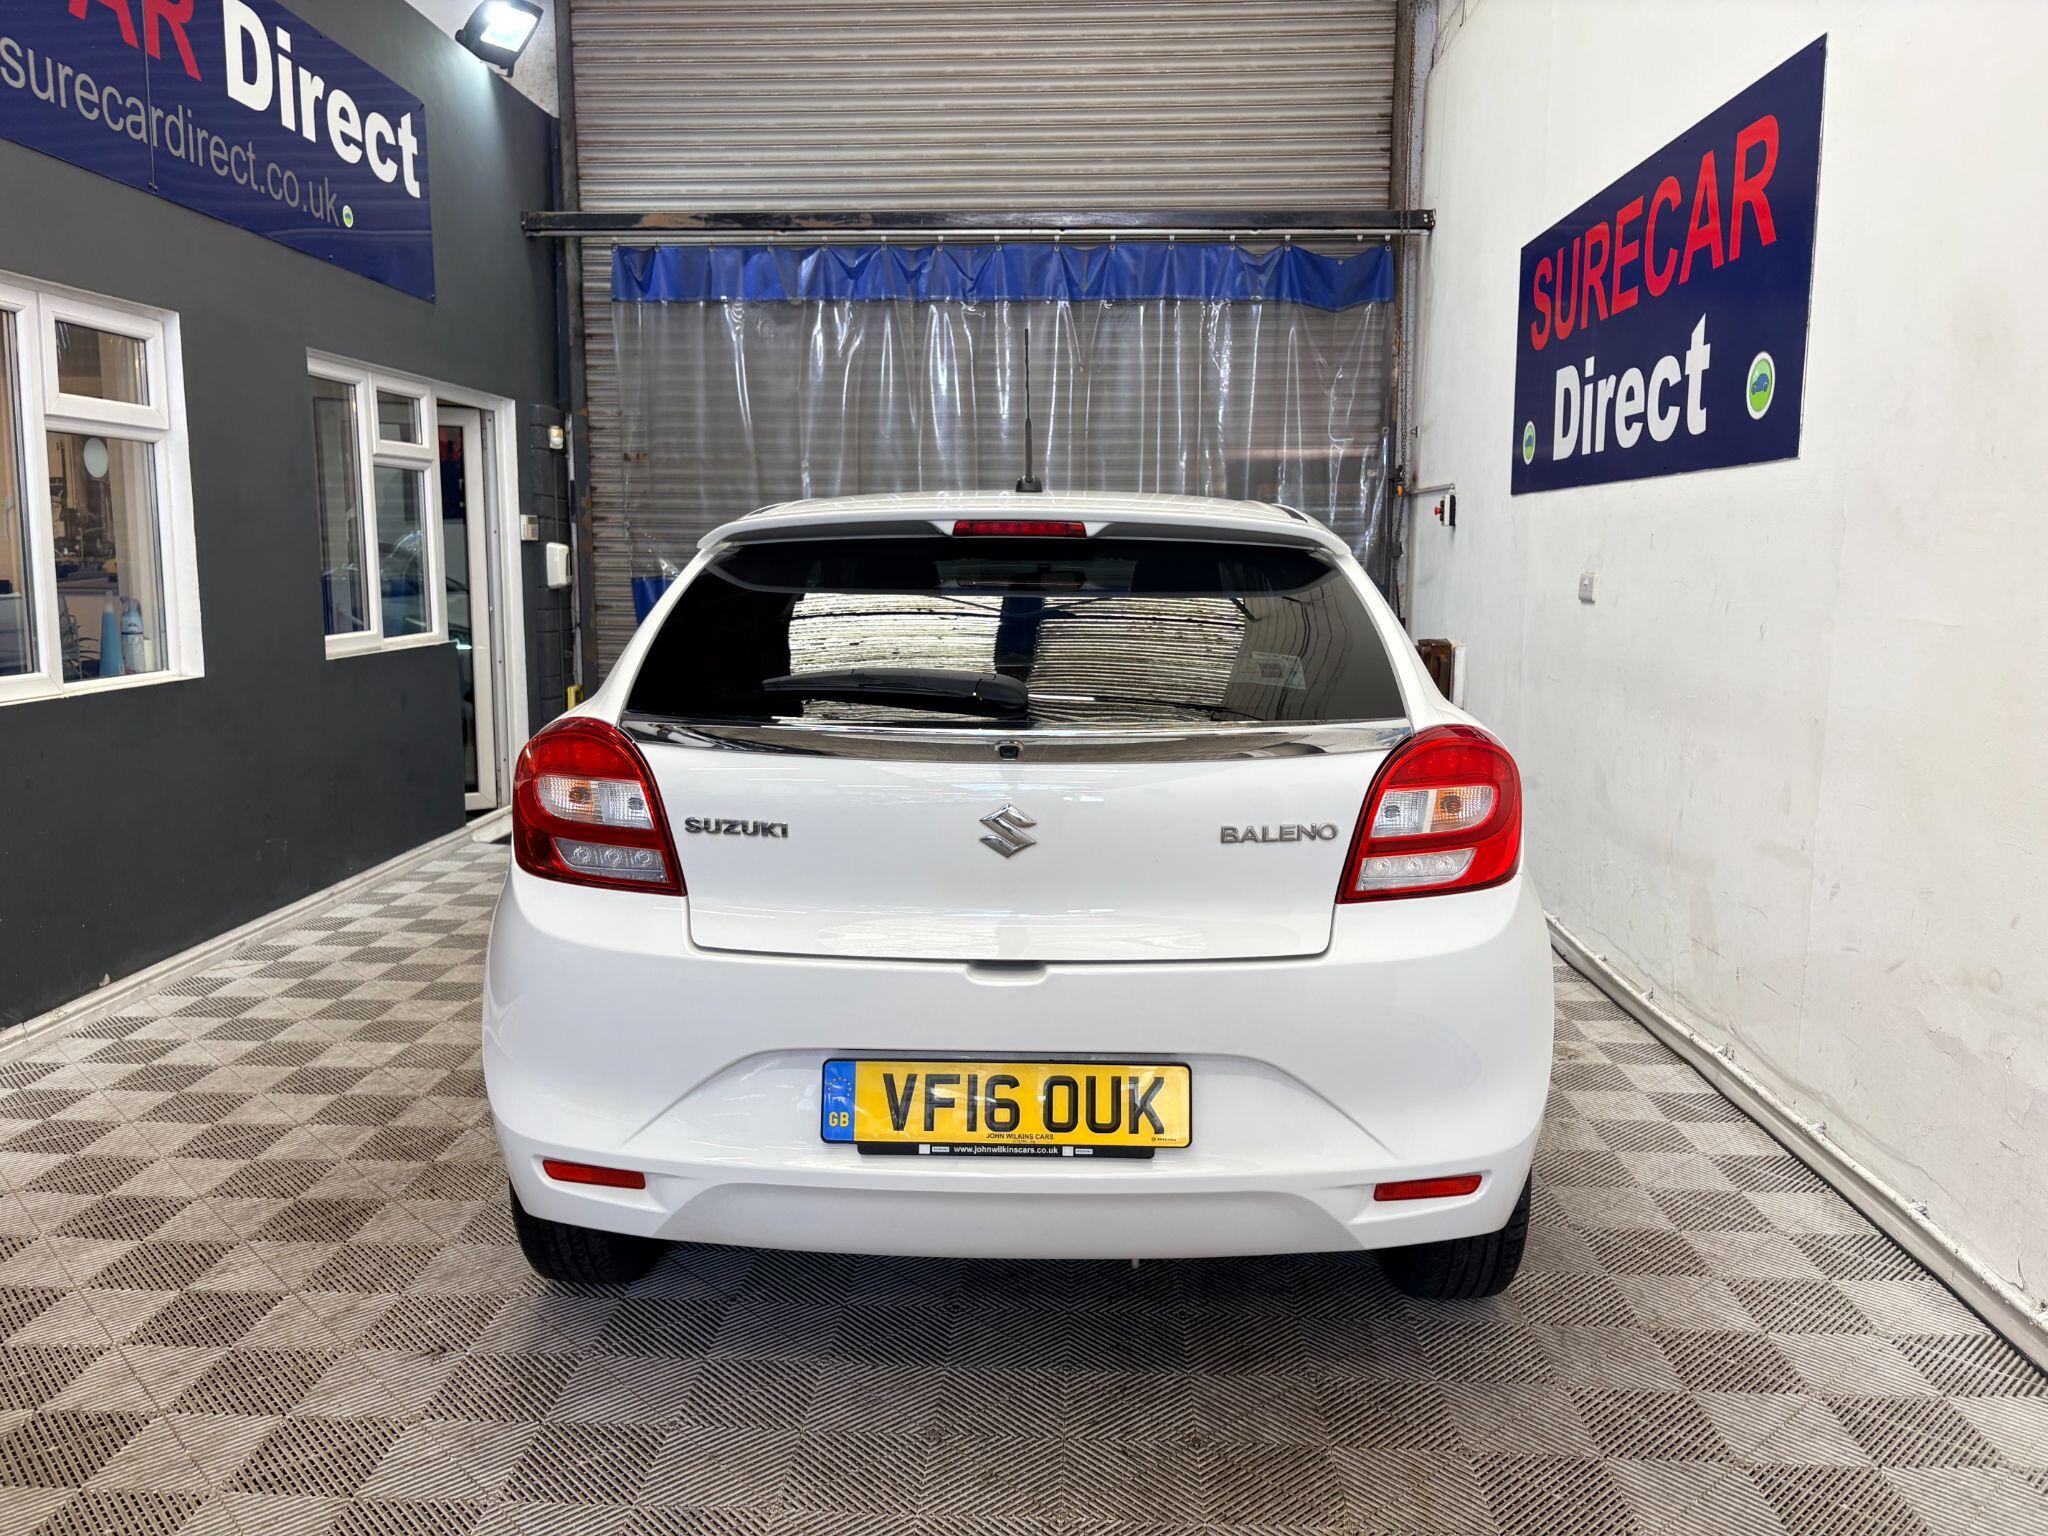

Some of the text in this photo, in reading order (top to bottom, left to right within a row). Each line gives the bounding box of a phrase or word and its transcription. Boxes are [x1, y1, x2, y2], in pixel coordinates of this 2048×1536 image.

[223, 0, 421, 199] Direct
[0, 37, 340, 227] surecardirect.co.uk
[1530, 114, 1780, 351] SURECAR
[1552, 312, 1711, 462] Direct
[684, 816, 789, 839] SUZUKI
[1220, 822, 1339, 844] BALENO
[828, 1111, 850, 1128] GB
[882, 1073, 1165, 1135] VF16 OUK
[953, 1145, 1059, 1155] www.johnwilkinscars.co.uk
[986, 1132, 1054, 1141] JOHN WILKINS CARS
